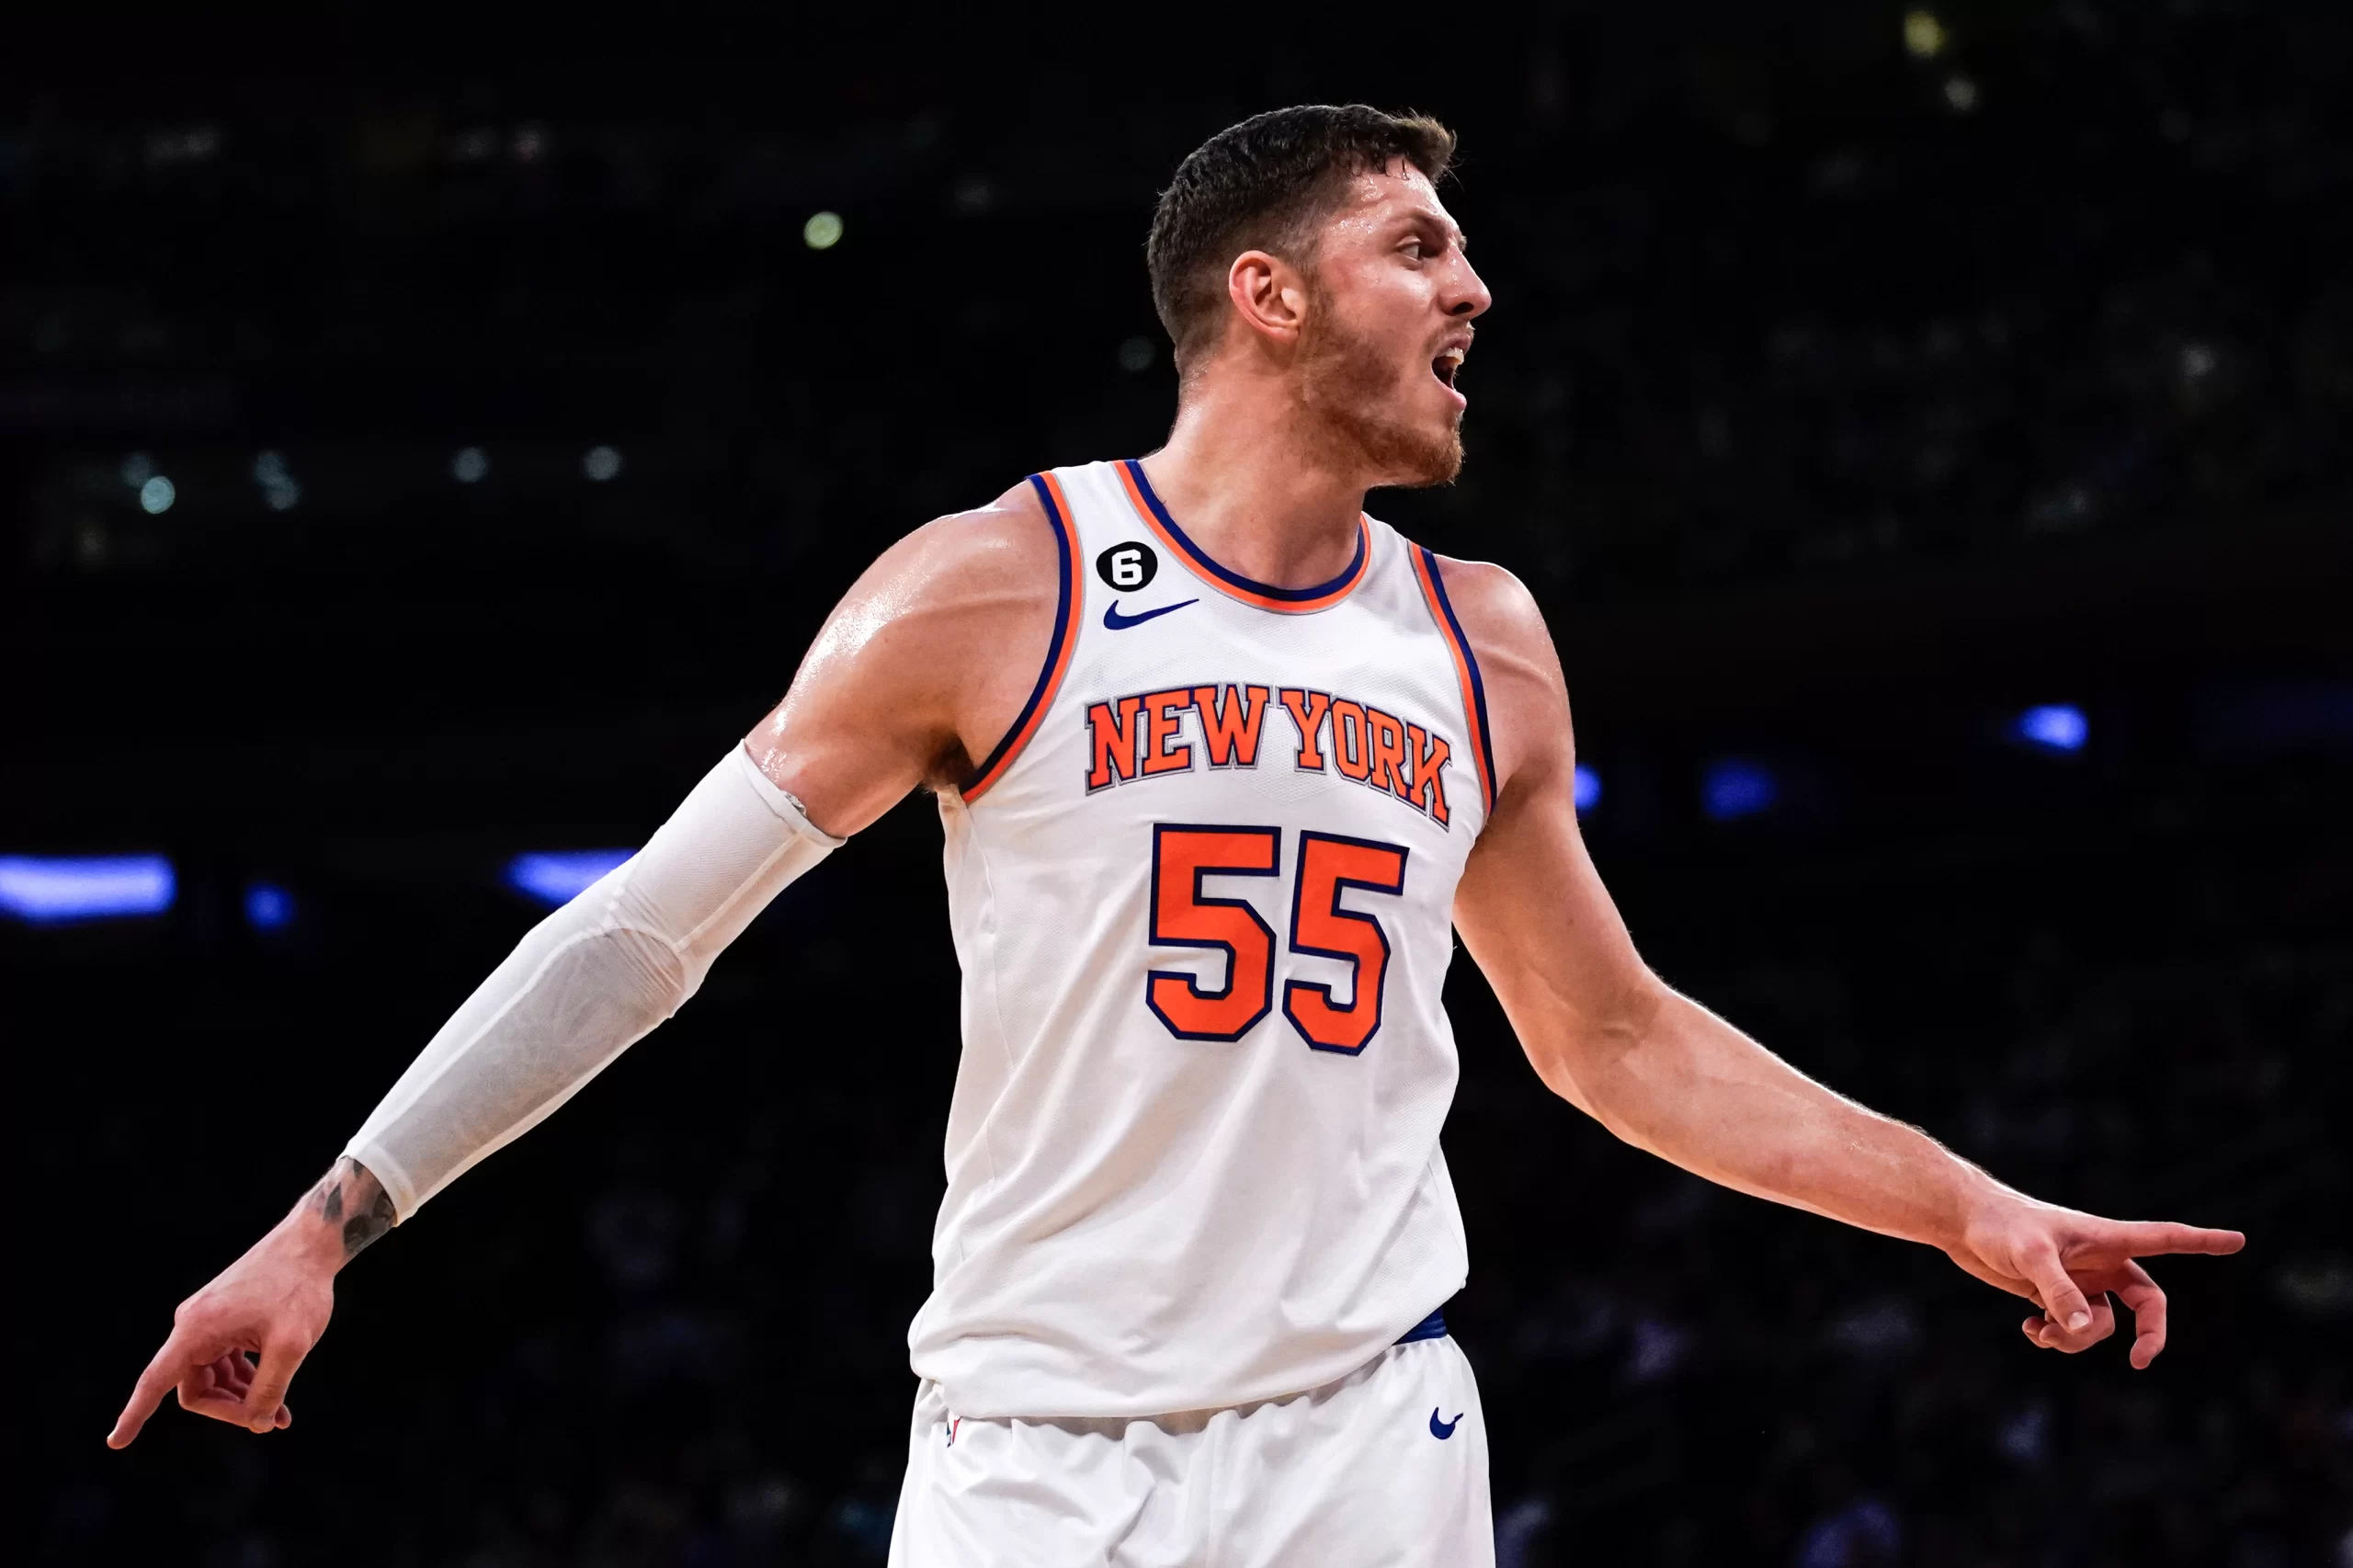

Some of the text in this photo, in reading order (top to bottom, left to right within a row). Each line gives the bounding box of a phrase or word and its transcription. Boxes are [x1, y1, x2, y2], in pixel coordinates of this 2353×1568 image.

[1111, 549, 1142, 585] 6
[1085, 682, 1451, 831] NEW YORK
[1145, 823, 1410, 1056] 55
